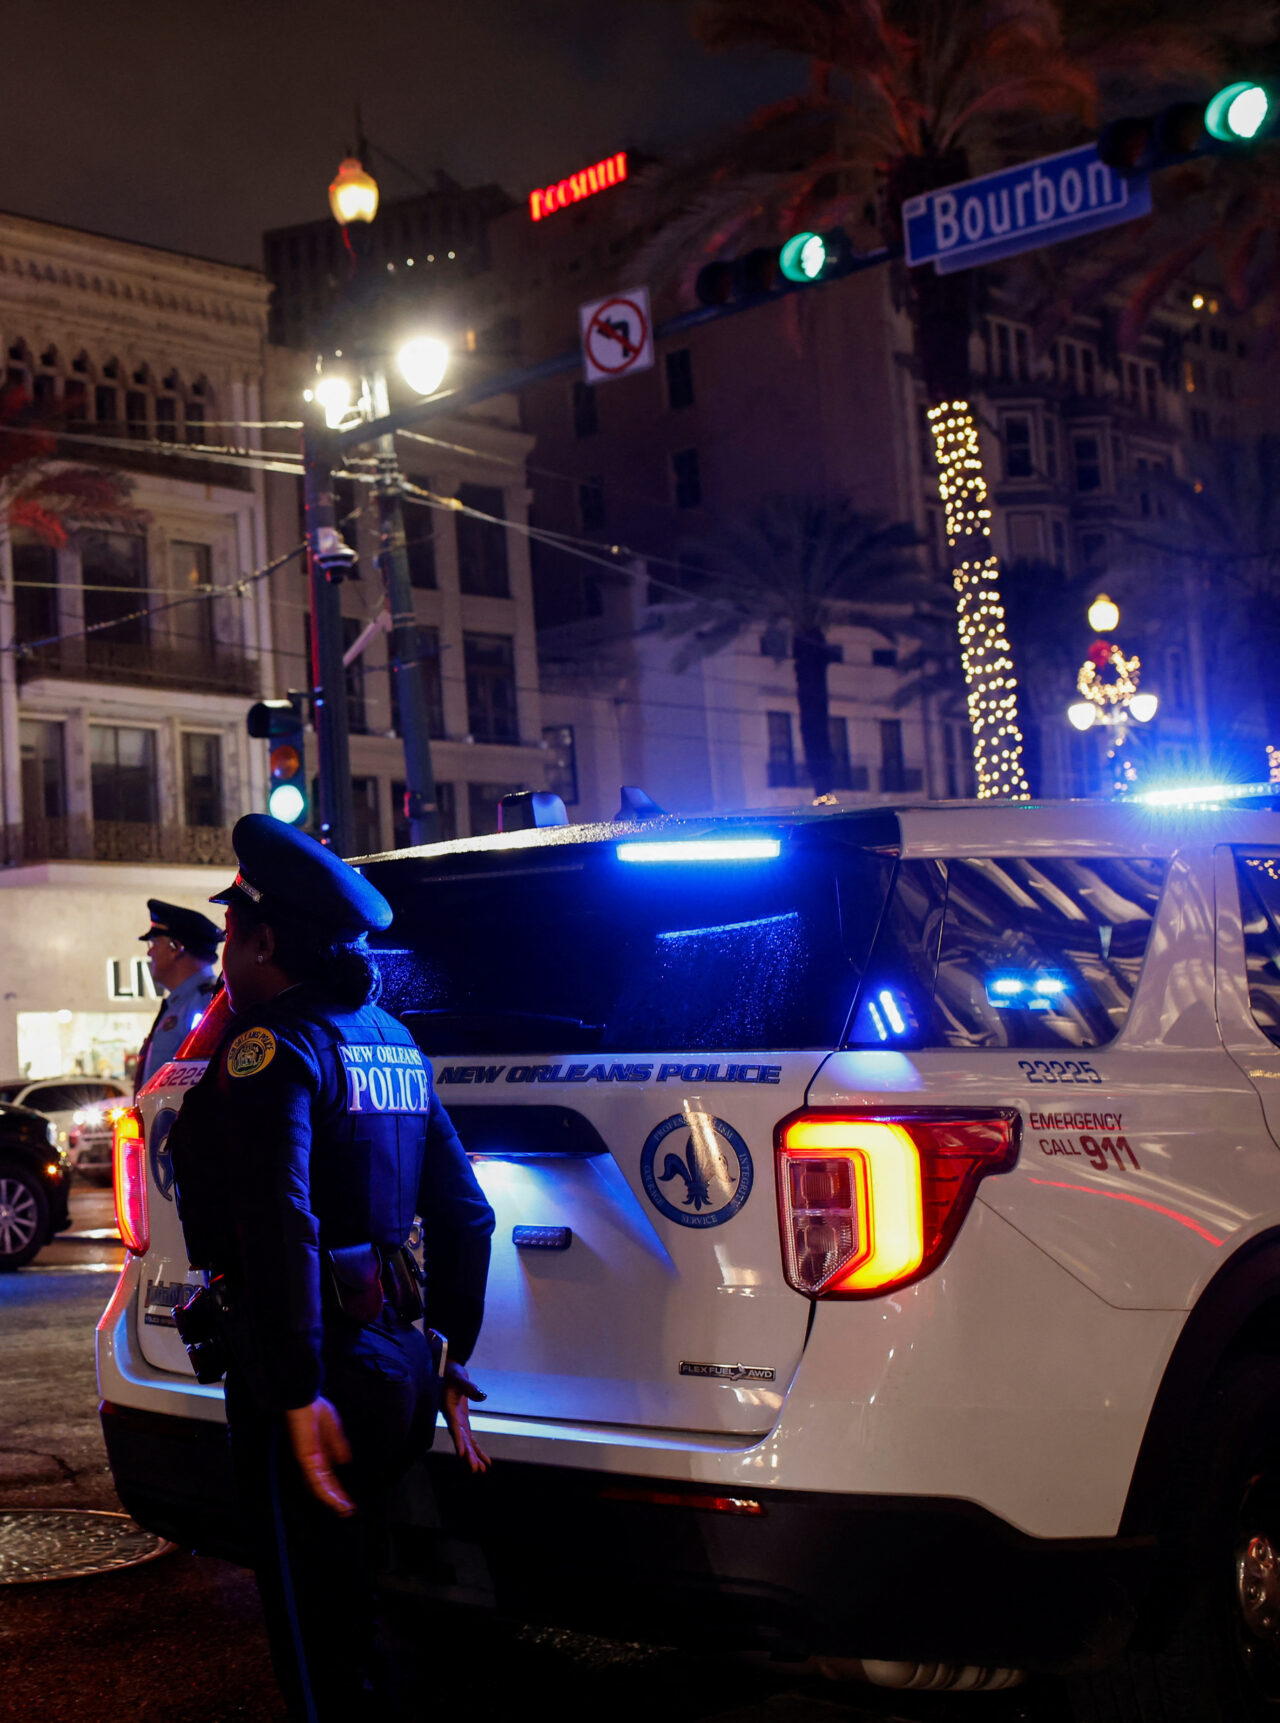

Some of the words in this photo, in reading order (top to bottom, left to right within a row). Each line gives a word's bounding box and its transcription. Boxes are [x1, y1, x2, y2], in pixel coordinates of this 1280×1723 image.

[933, 161, 1114, 250] Bourbon
[340, 1046, 373, 1063] NEW
[376, 1046, 422, 1066] ORLEANS
[436, 1065, 507, 1084] NEW
[505, 1063, 654, 1083] ORLEANS
[656, 1063, 782, 1084] POLICE
[1018, 1060, 1102, 1084] 23225
[347, 1067, 428, 1111] POLICE
[1029, 1112, 1122, 1131] EMERGENCY
[1039, 1138, 1081, 1155] CALL
[1079, 1135, 1141, 1171] 911
[681, 1214, 718, 1225] SERVICE
[682, 1364, 708, 1374] FLEX
[708, 1366, 735, 1375] FUEL
[747, 1370, 773, 1378] AWD
